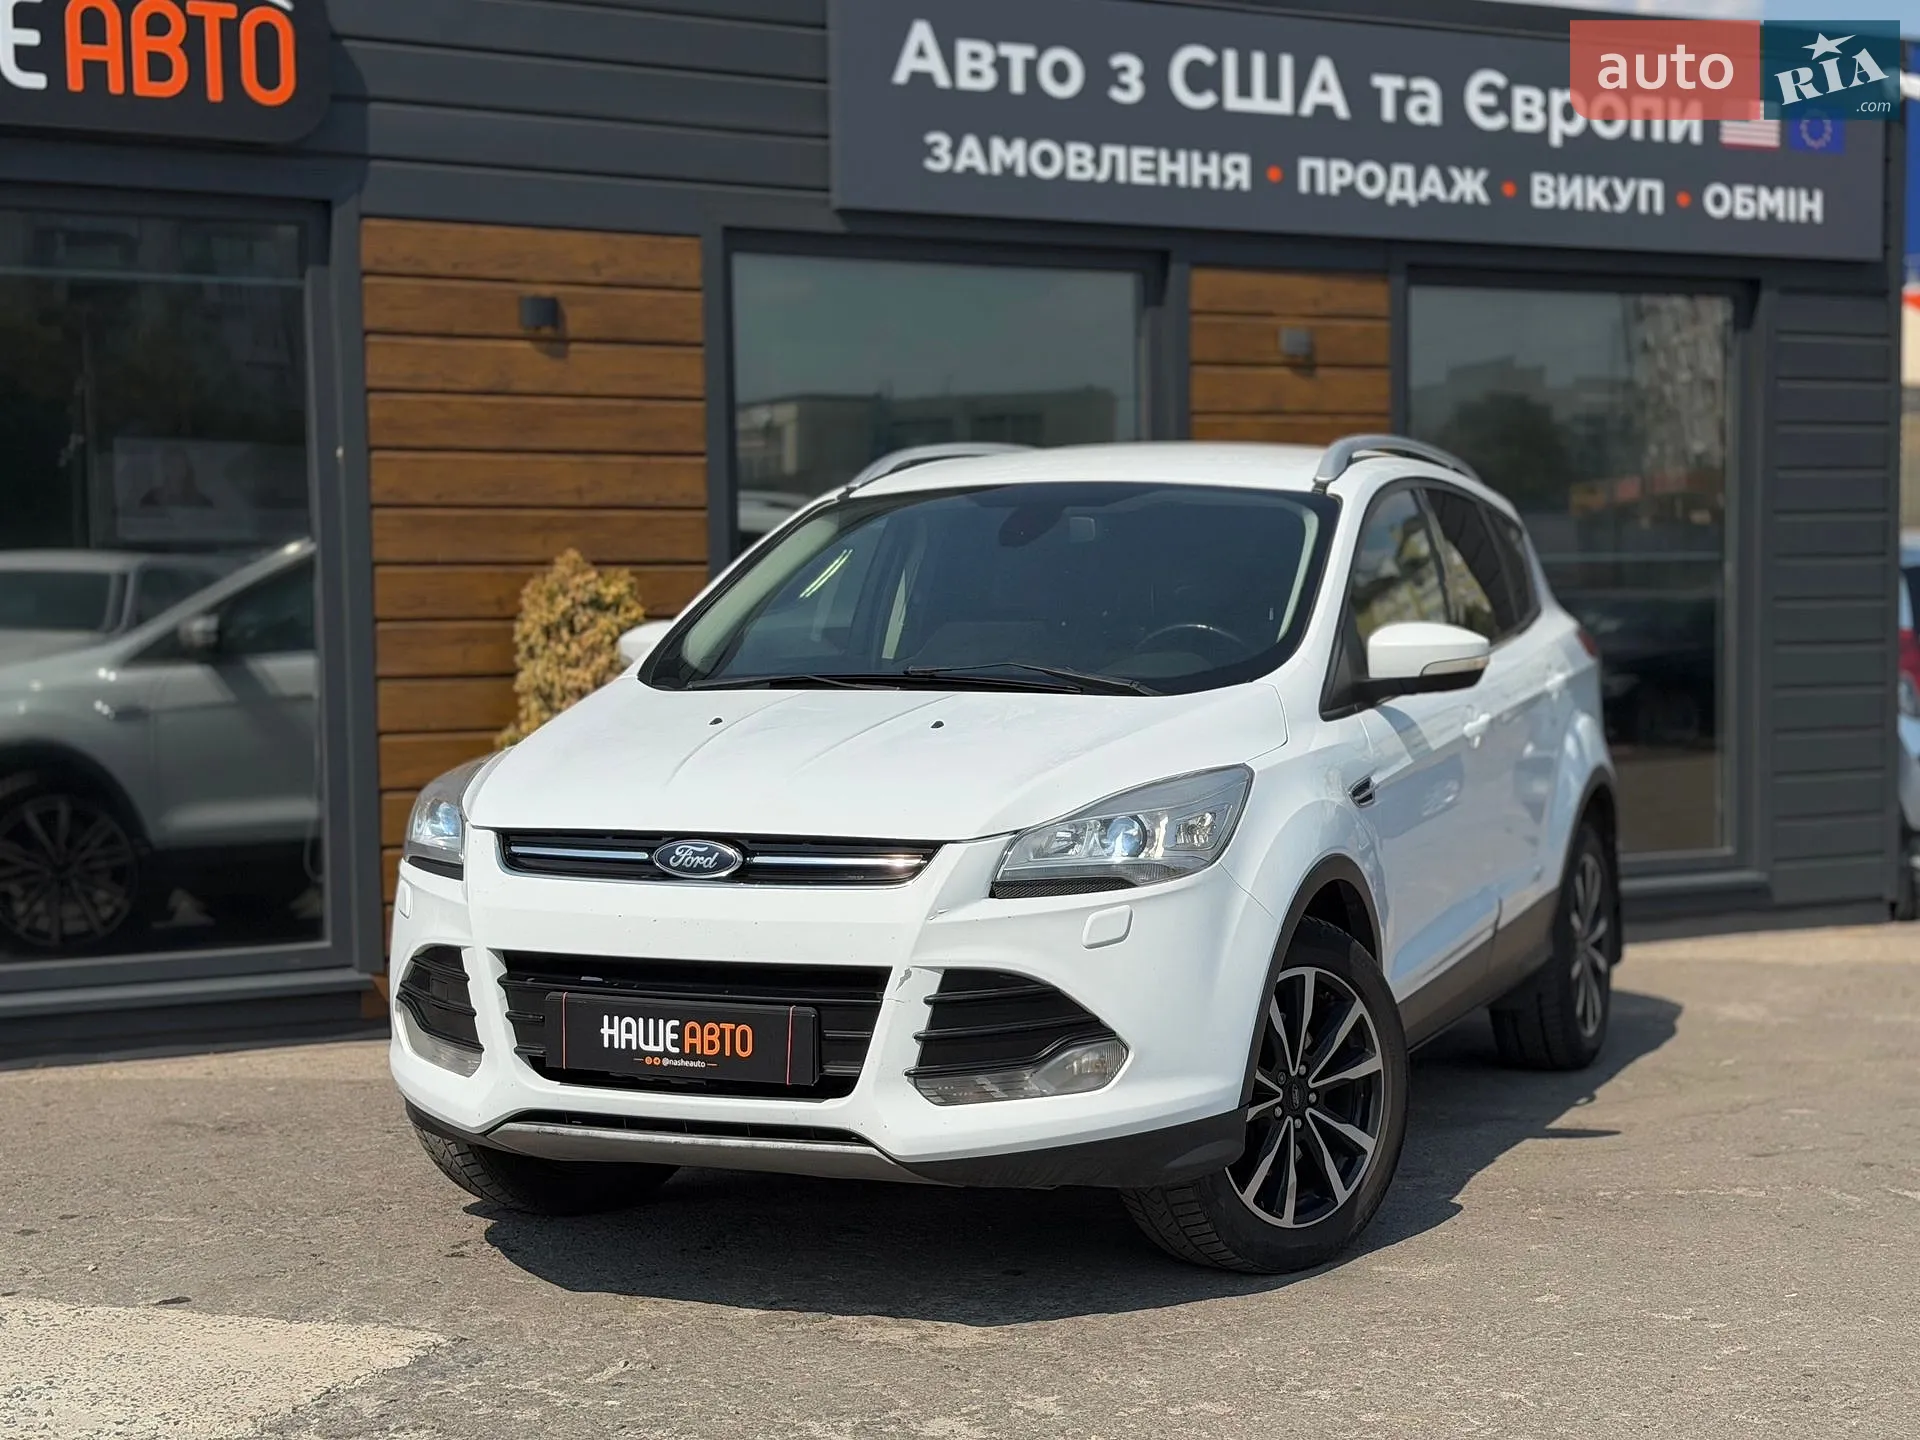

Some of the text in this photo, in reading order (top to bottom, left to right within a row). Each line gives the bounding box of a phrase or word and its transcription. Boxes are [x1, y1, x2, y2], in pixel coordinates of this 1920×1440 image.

[65, 0, 296, 107] АВТО
[891, 19, 1704, 149] Авто з США та Європи
[923, 131, 1824, 225] ЗАМОВЛЕННЯ ПРОДАЖ ВИКУП ОБМІН
[669, 844, 720, 869] Ford
[600, 1014, 754, 1058] НАШЕ АВТО
[661, 1056, 706, 1068] @nasheauto
